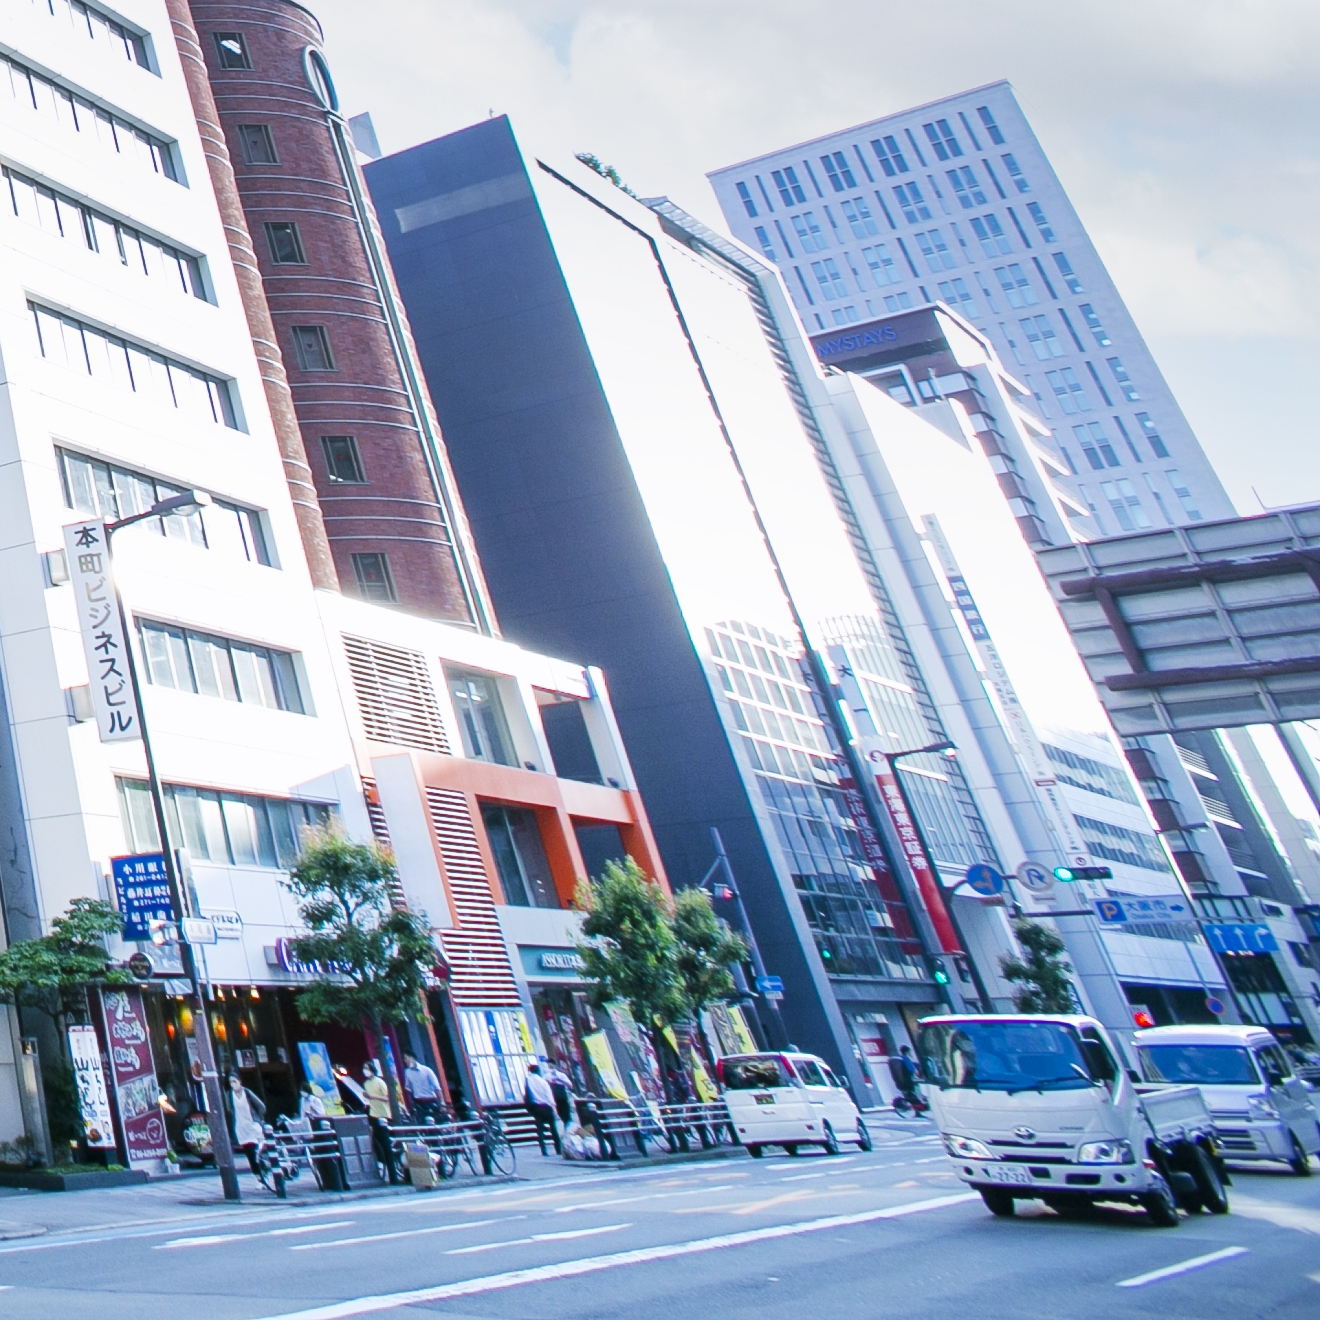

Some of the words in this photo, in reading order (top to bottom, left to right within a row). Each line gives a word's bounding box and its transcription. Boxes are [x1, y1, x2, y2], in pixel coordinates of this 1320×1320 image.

[817, 327, 897, 357] MYSTAYS
[74, 526, 133, 733] 本町ビジネスビル
